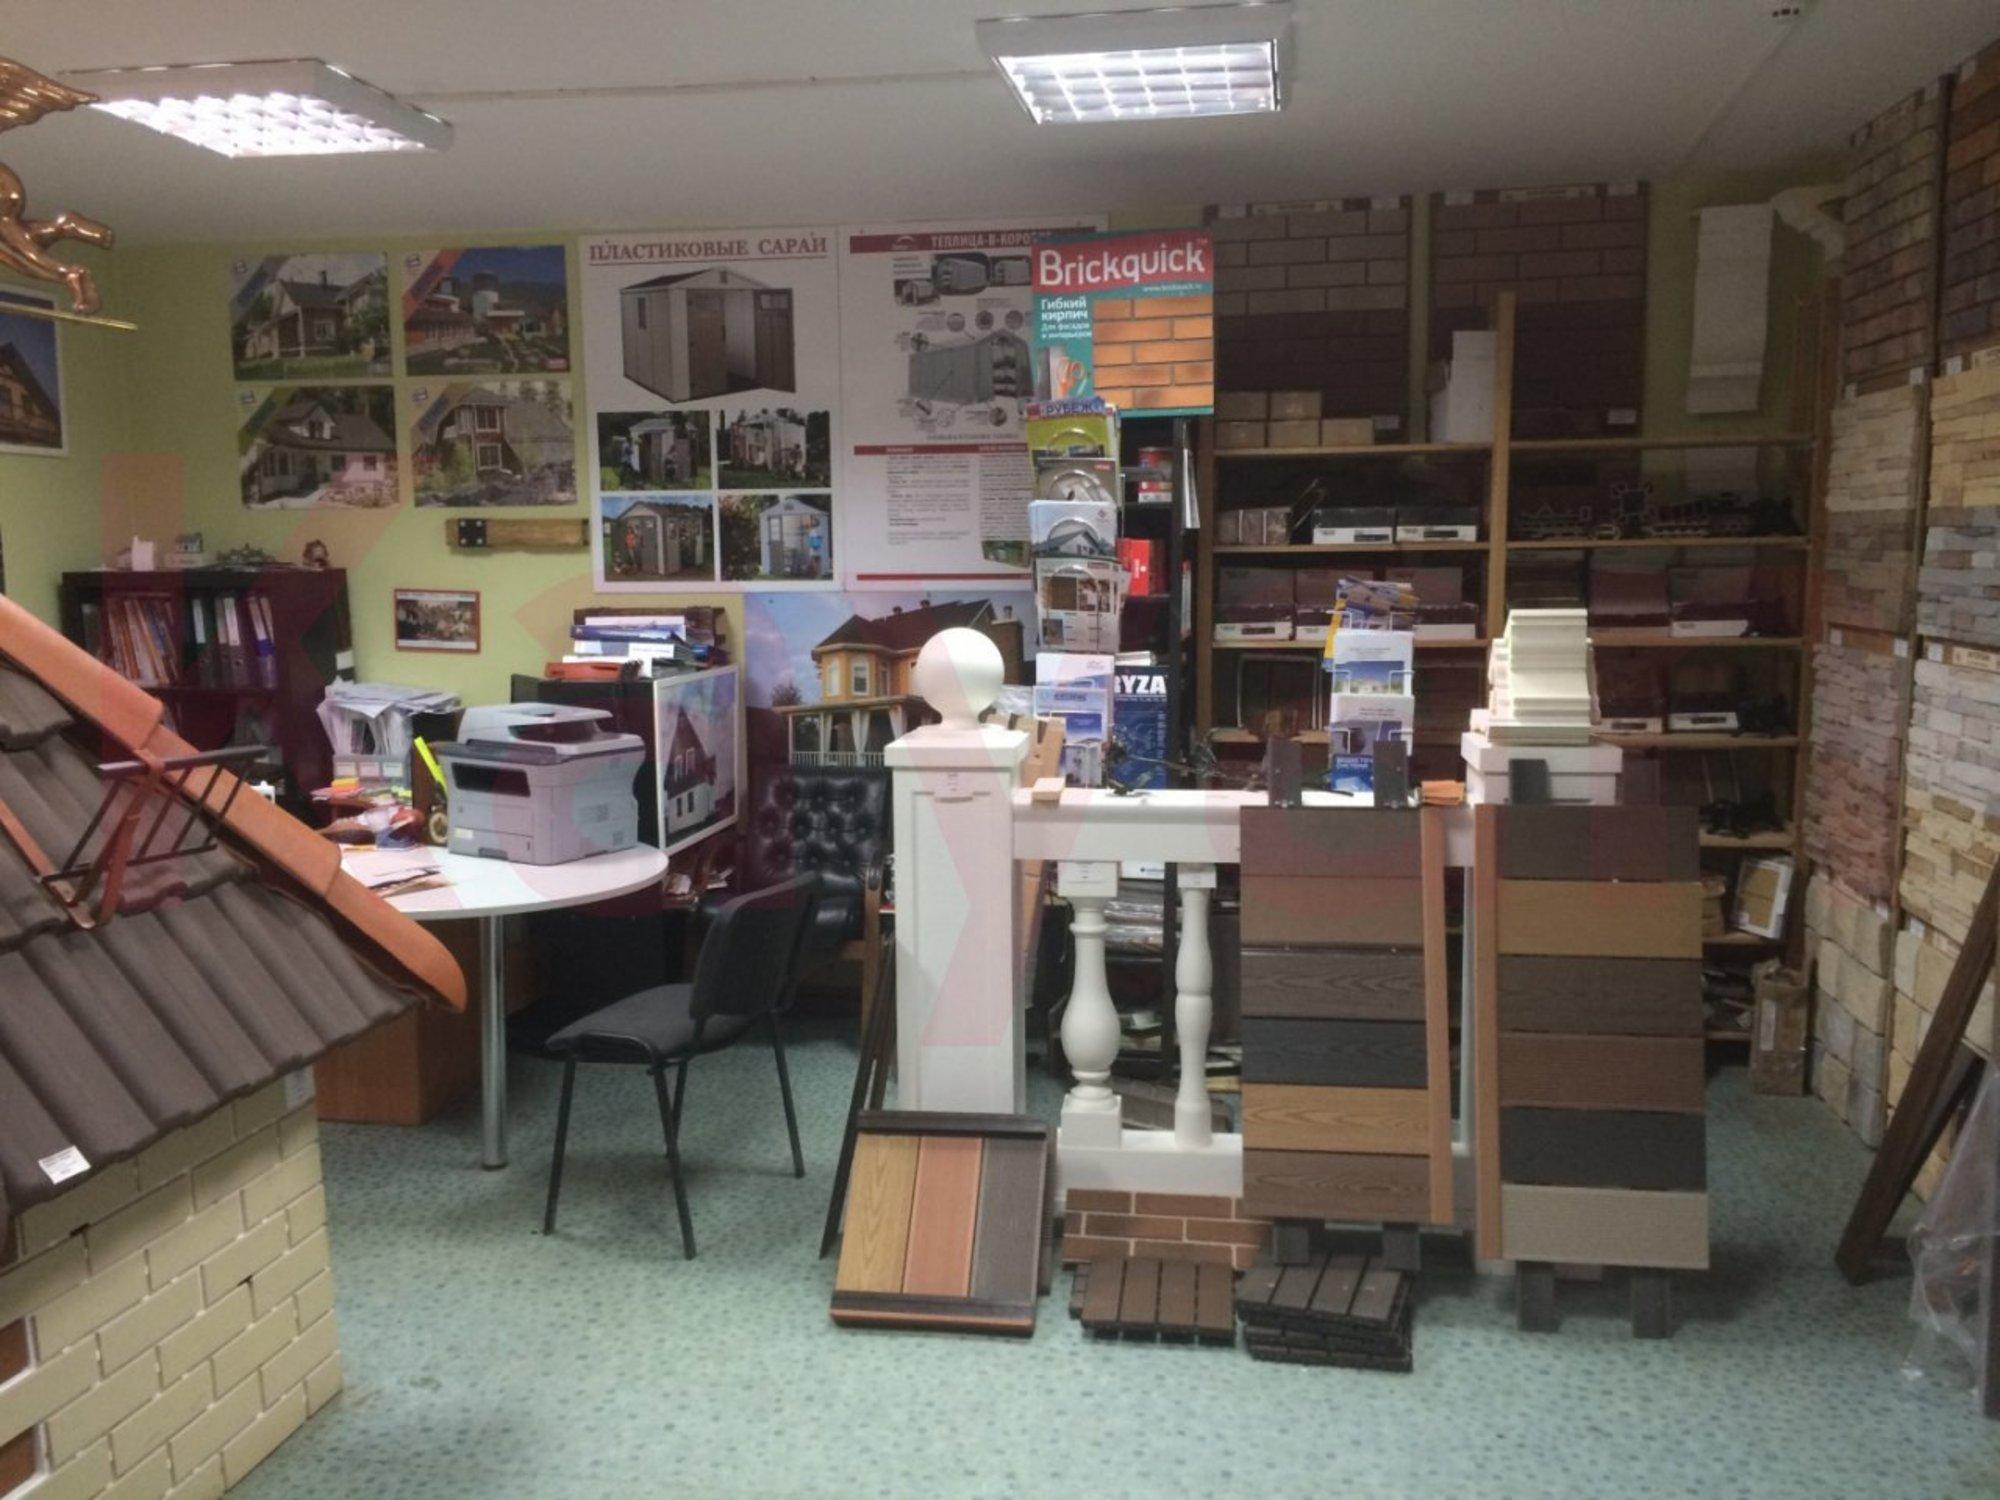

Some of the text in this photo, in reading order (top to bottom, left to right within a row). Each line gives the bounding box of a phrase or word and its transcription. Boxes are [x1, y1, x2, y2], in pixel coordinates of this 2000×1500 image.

[589, 240, 749, 260] ПЛАСТИКОВЫЕ
[1039, 242, 1205, 285] Brickquick
[1041, 296, 1087, 310] Гибкий
[1041, 310, 1088, 323] кирпич
